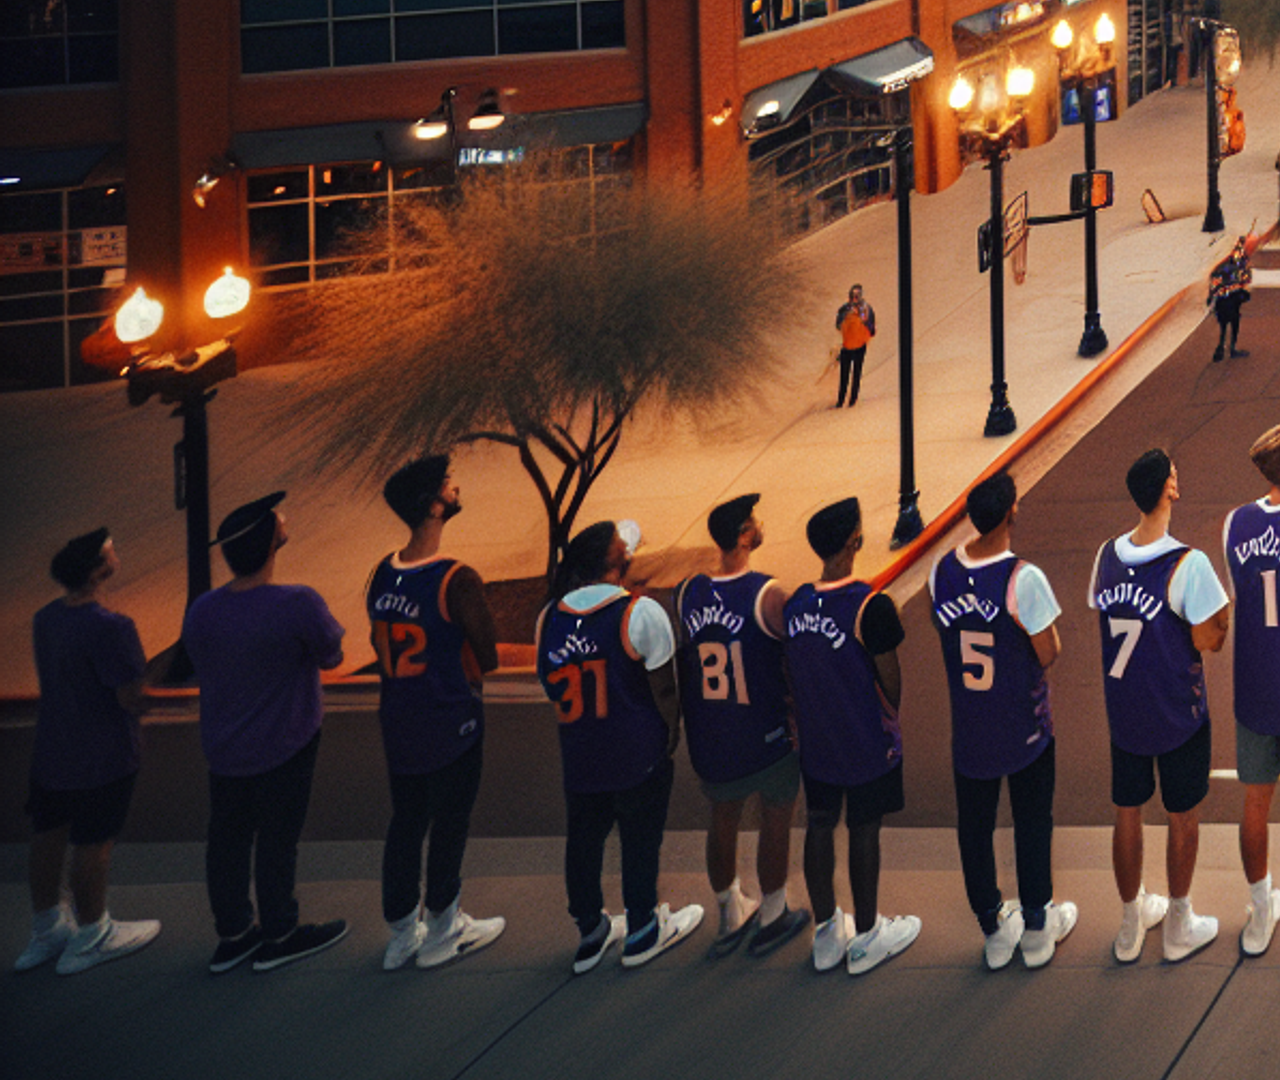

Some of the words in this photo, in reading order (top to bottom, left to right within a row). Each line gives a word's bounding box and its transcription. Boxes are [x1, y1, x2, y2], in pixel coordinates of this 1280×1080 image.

[1260, 570, 1279, 627] 1
[960, 630, 995, 691] 5
[1107, 617, 1143, 679] 7
[547, 659, 608, 723] 31
